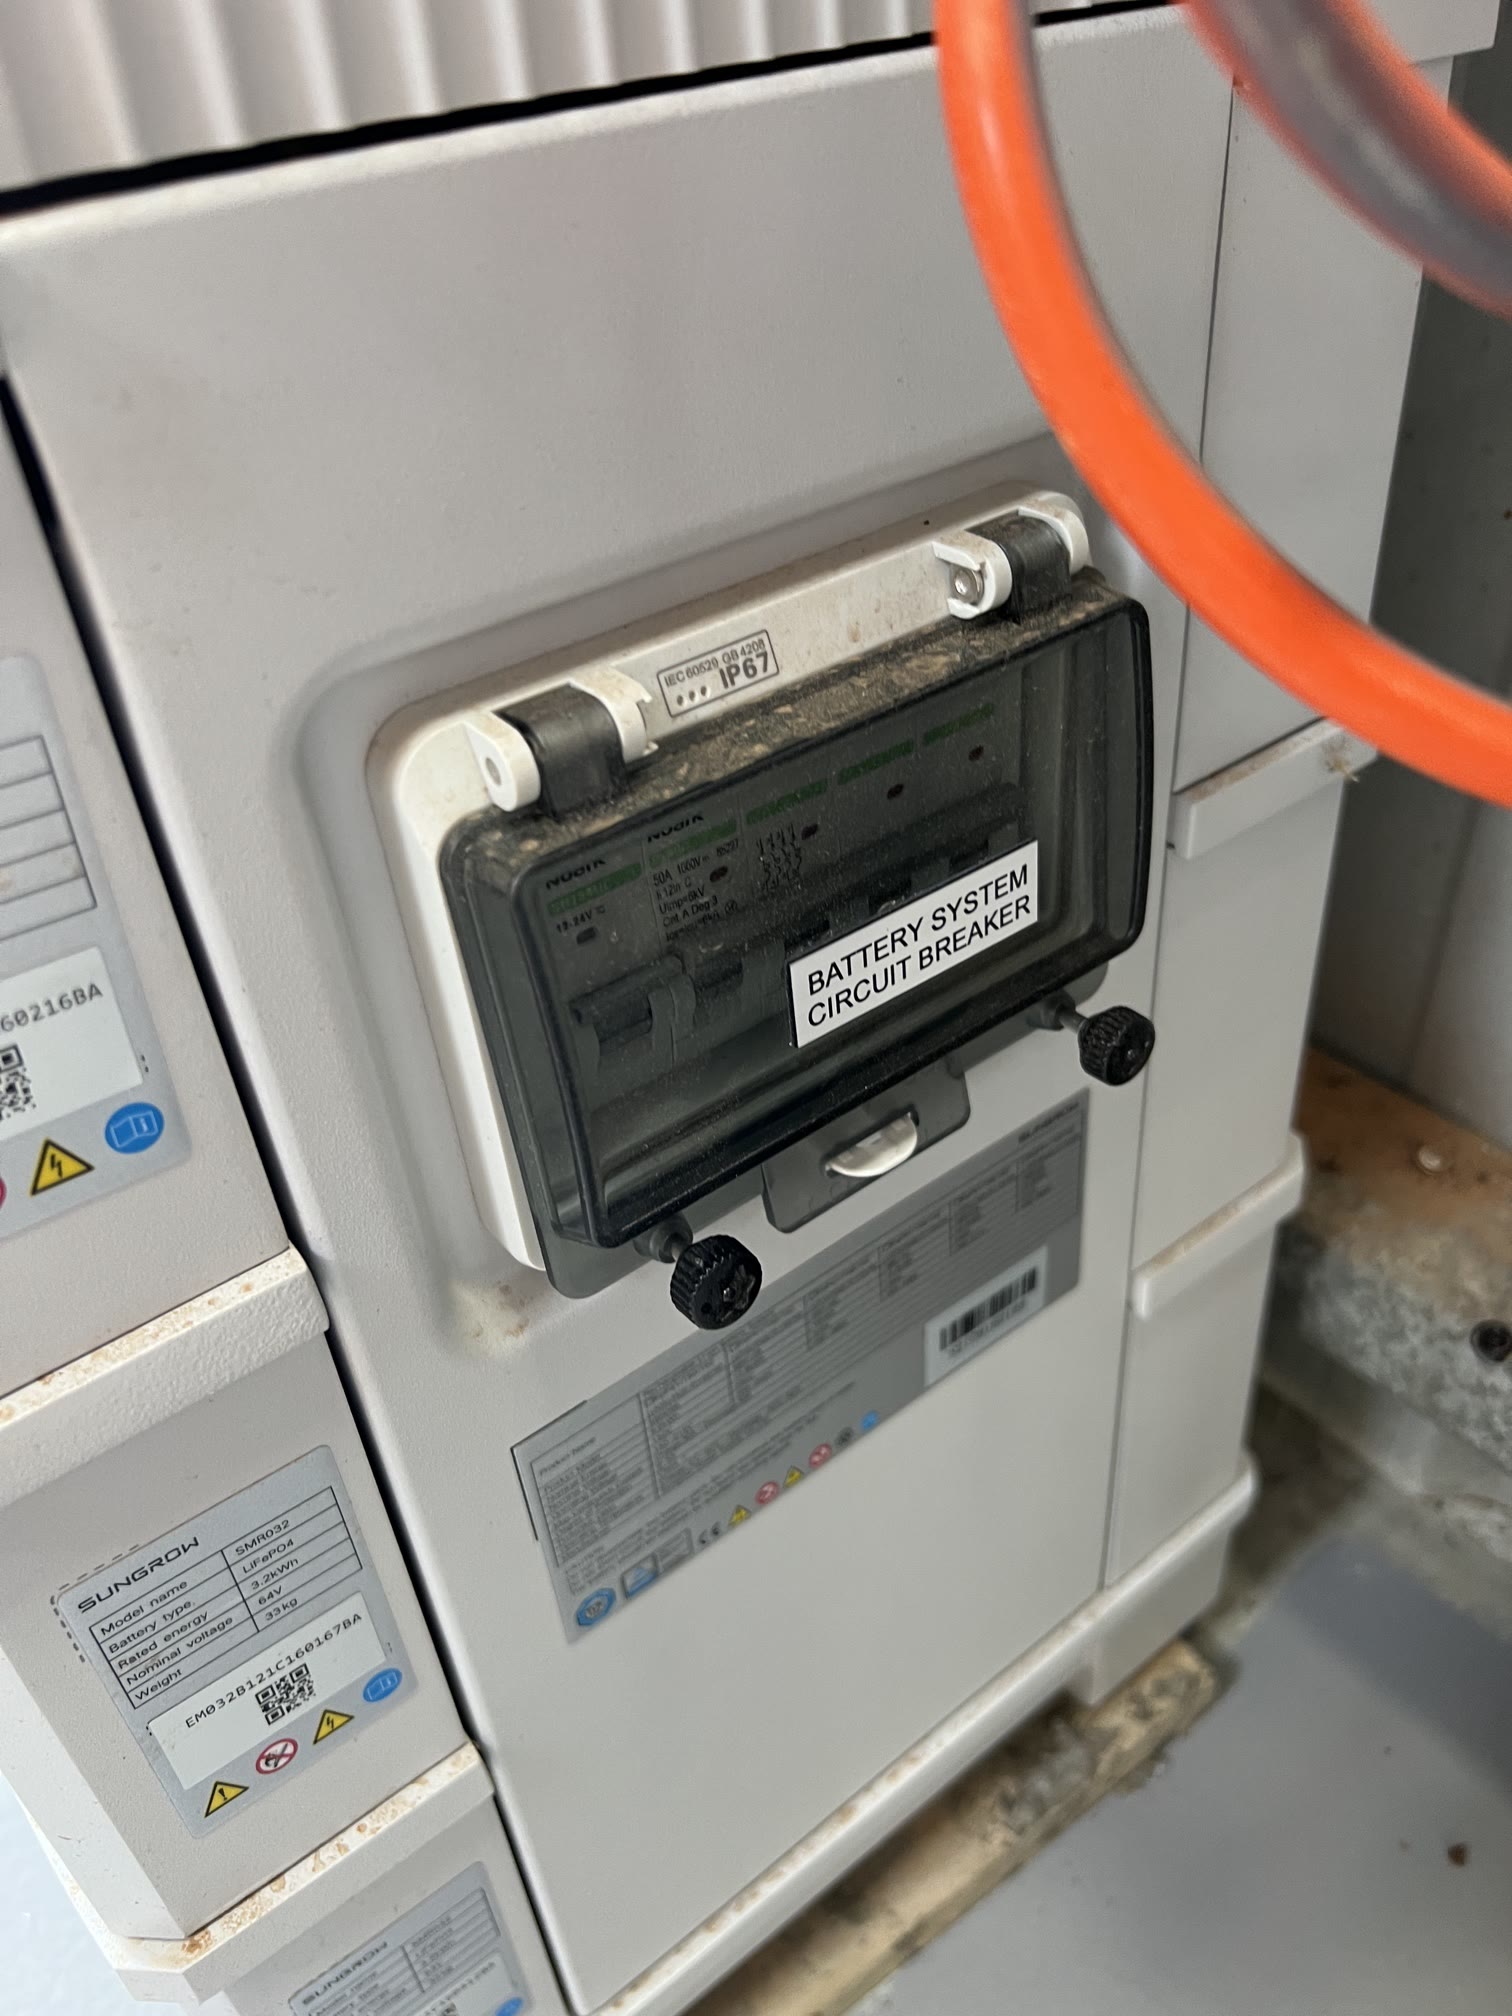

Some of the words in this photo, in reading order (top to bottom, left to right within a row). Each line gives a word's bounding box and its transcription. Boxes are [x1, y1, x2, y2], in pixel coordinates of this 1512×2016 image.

[664, 670, 686, 687] IEC
[719, 650, 768, 689] IP67
[808, 916, 924, 996] BATTERY
[931, 863, 1028, 932] SYSTEM
[808, 955, 912, 1027] CIRCUIT
[919, 895, 1031, 971] BREAKER
[0, 983, 103, 1032] 60216BA
[78, 1537, 199, 1614] SUNGROW
[100, 1606, 144, 1636] Model
[150, 1581, 188, 1608] name
[235, 1519, 290, 1556] SMR032
[109, 1621, 157, 1653] Battery
[162, 1601, 192, 1625] type
[242, 1538, 295, 1574] LiFePO4
[118, 1641, 158, 1669] Rated
[163, 1611, 208, 1642] energy
[251, 1557, 299, 1590] 3.2kWh
[126, 1648, 181, 1685] Nominal
[186, 1616, 233, 1648] voltage
[258, 1585, 282, 1605] 64V
[135, 1668, 182, 1700] Weight
